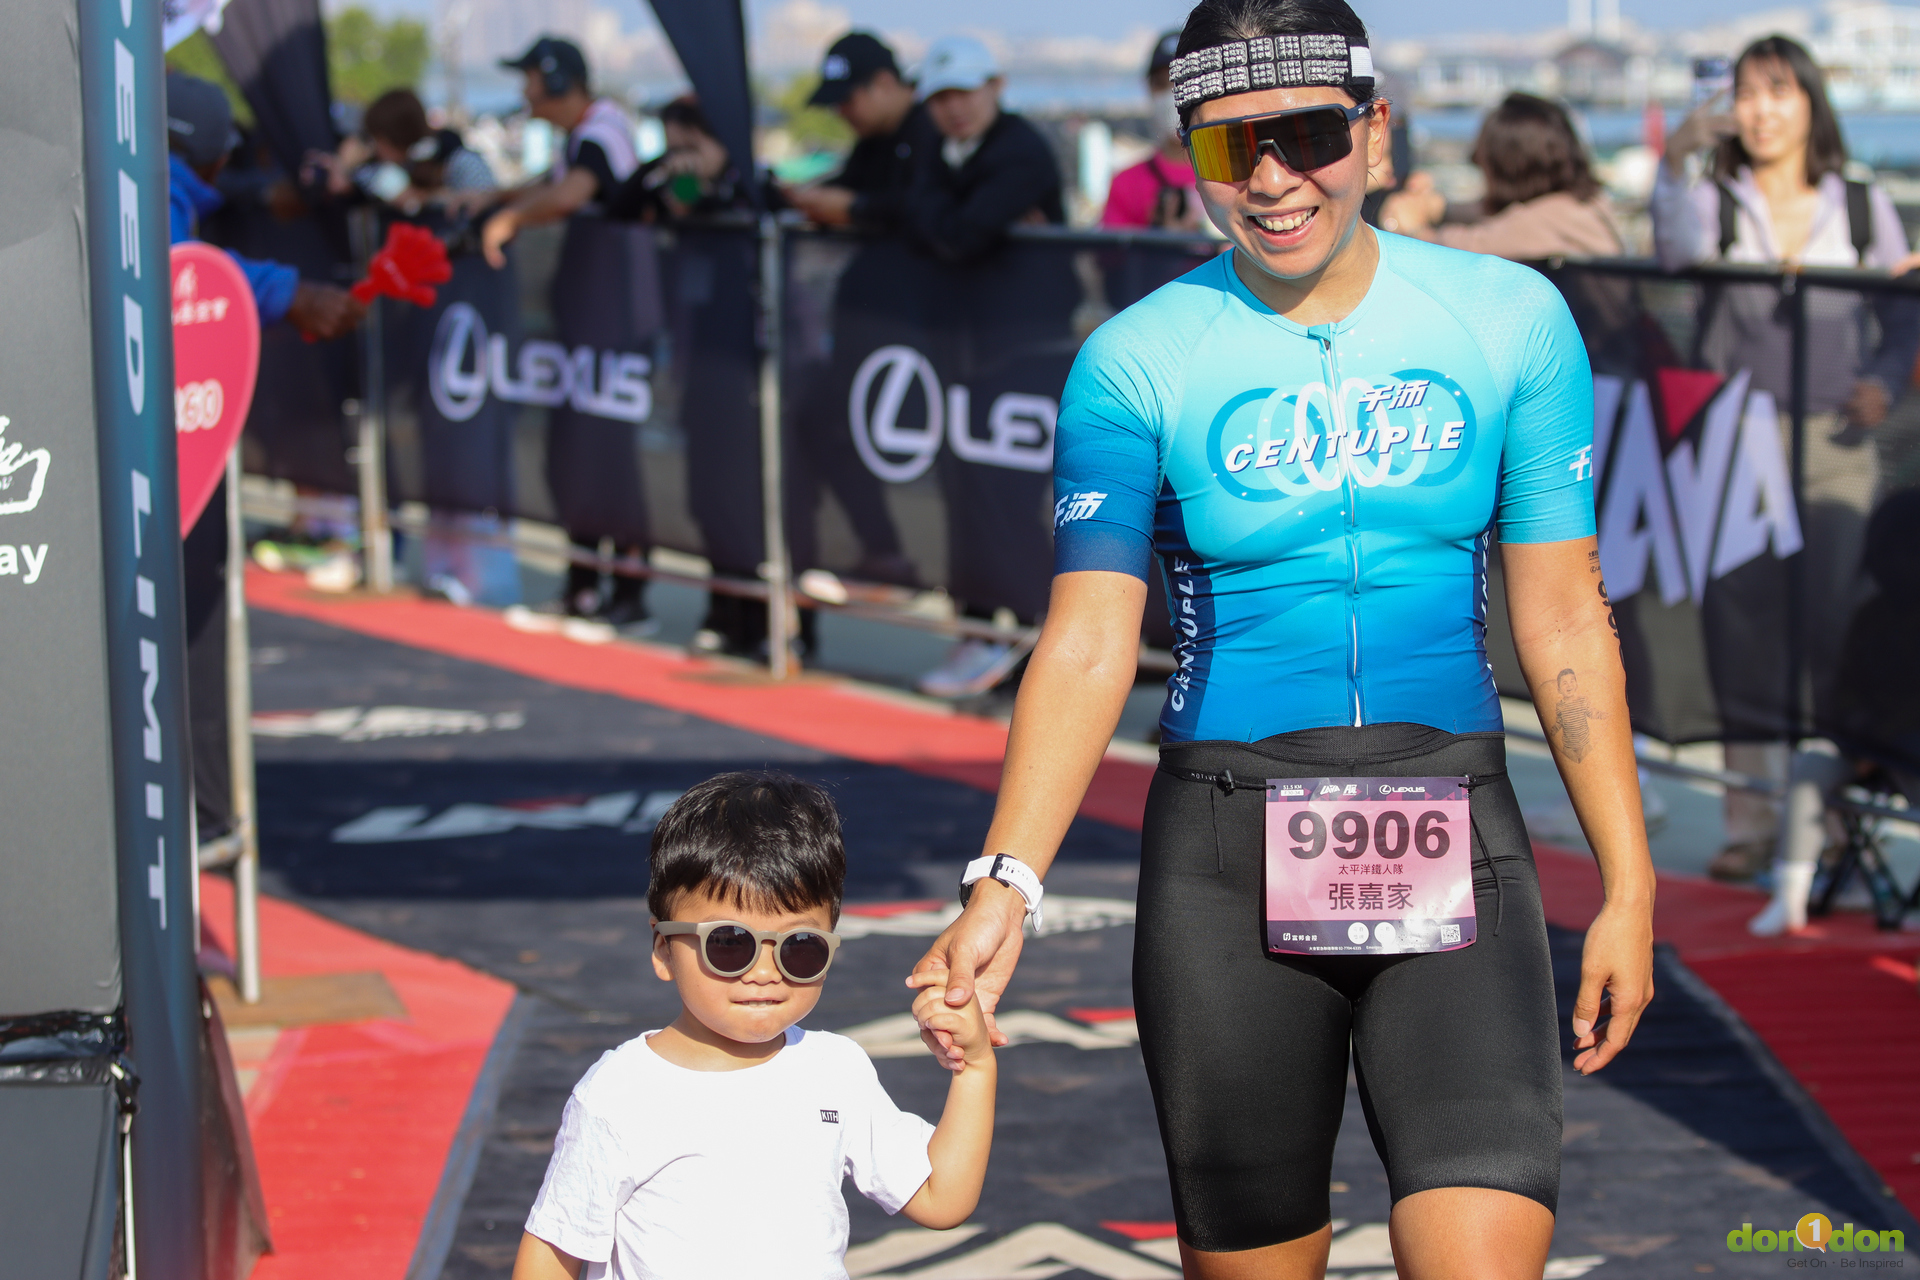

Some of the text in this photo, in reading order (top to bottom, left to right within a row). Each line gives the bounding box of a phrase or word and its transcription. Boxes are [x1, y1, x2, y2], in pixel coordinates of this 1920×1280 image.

[489, 332, 653, 425] LEXUS
[1224, 420, 1466, 474] CENTUPLE
[131, 467, 167, 931] LIMIT
[1287, 810, 1450, 860] 9906
[1338, 863, 1404, 876] 太平洋鐵人隊
[1328, 882, 1414, 911] 張嘉家
[821, 1110, 839, 1123] KITH
